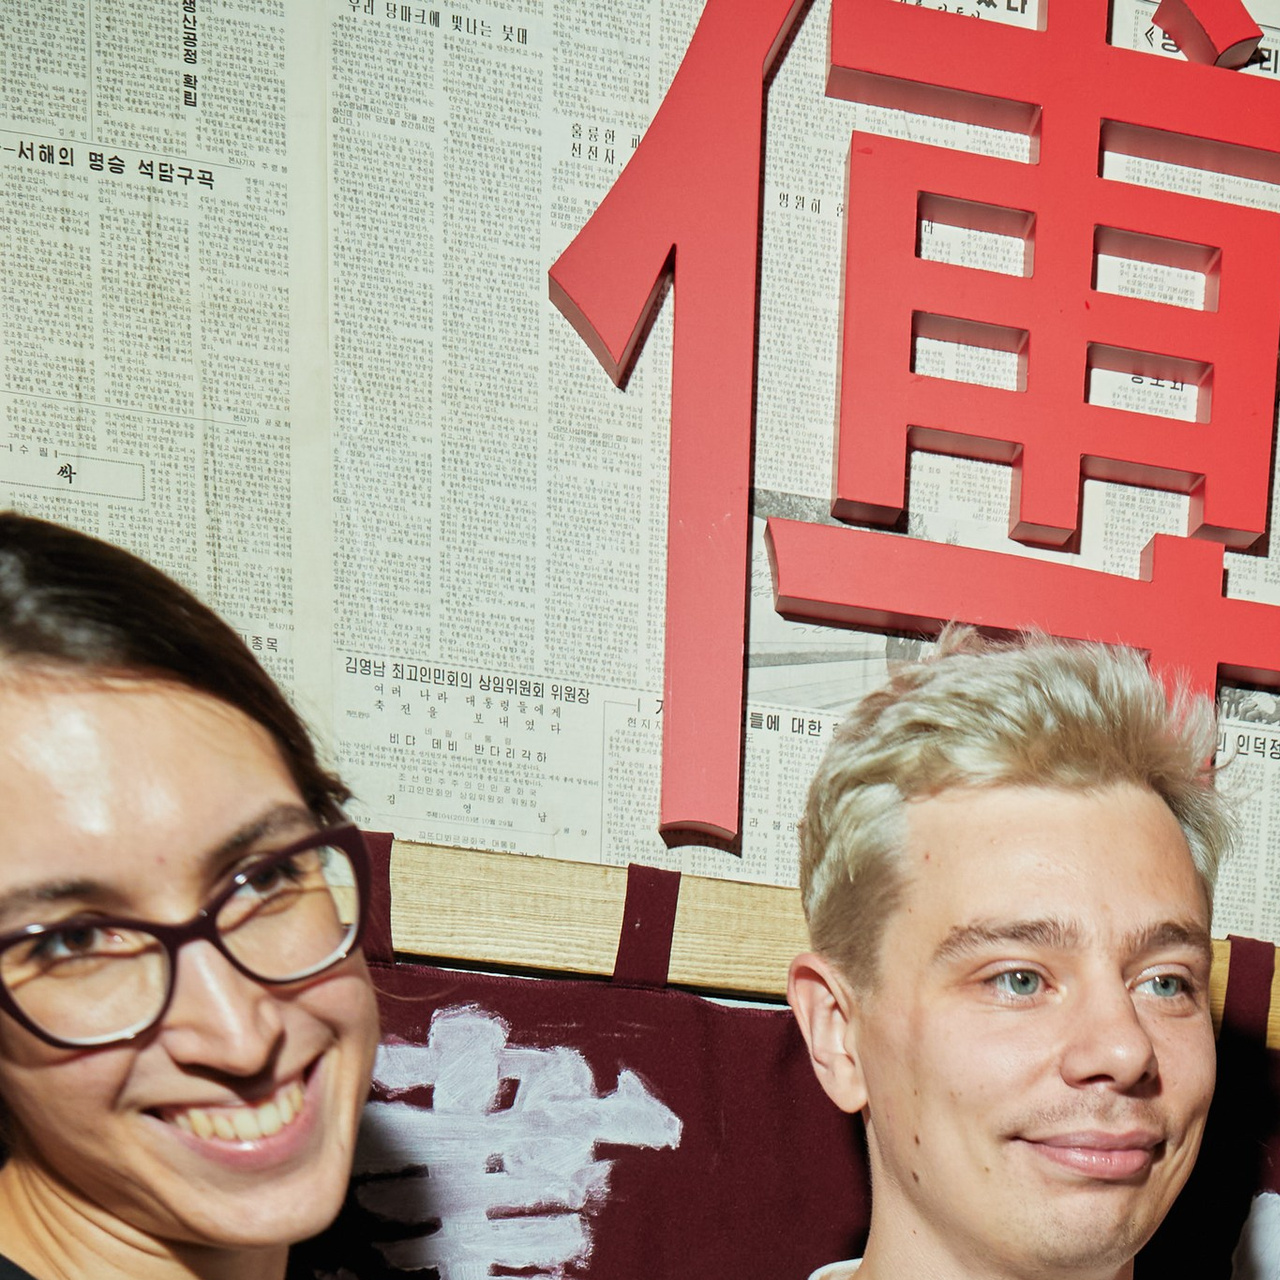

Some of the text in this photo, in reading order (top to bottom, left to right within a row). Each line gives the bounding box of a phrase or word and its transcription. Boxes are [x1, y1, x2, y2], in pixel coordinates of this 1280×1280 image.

[386, 2, 440, 28] 당마크에
[452, 14, 492, 38] 빛나는
[502, 24, 528, 45] 붓대
[183, 74, 198, 107] 확립
[571, 122, 615, 145] 훌륭한
[18, 140, 215, 190] 서해의 명승 석담구곡
[779, 192, 821, 214] 영원히
[57, 463, 77, 484] 싹
[345, 656, 590, 705] 김영남 최고인민회의 상임위원회 위원장
[374, 683, 401, 698] 여러
[420, 688, 448, 703] 나라
[374, 699, 438, 719] 축전을
[750, 711, 780, 732] 들에
[791, 717, 822, 737] 대한
[432, 738, 458, 752] 데비
